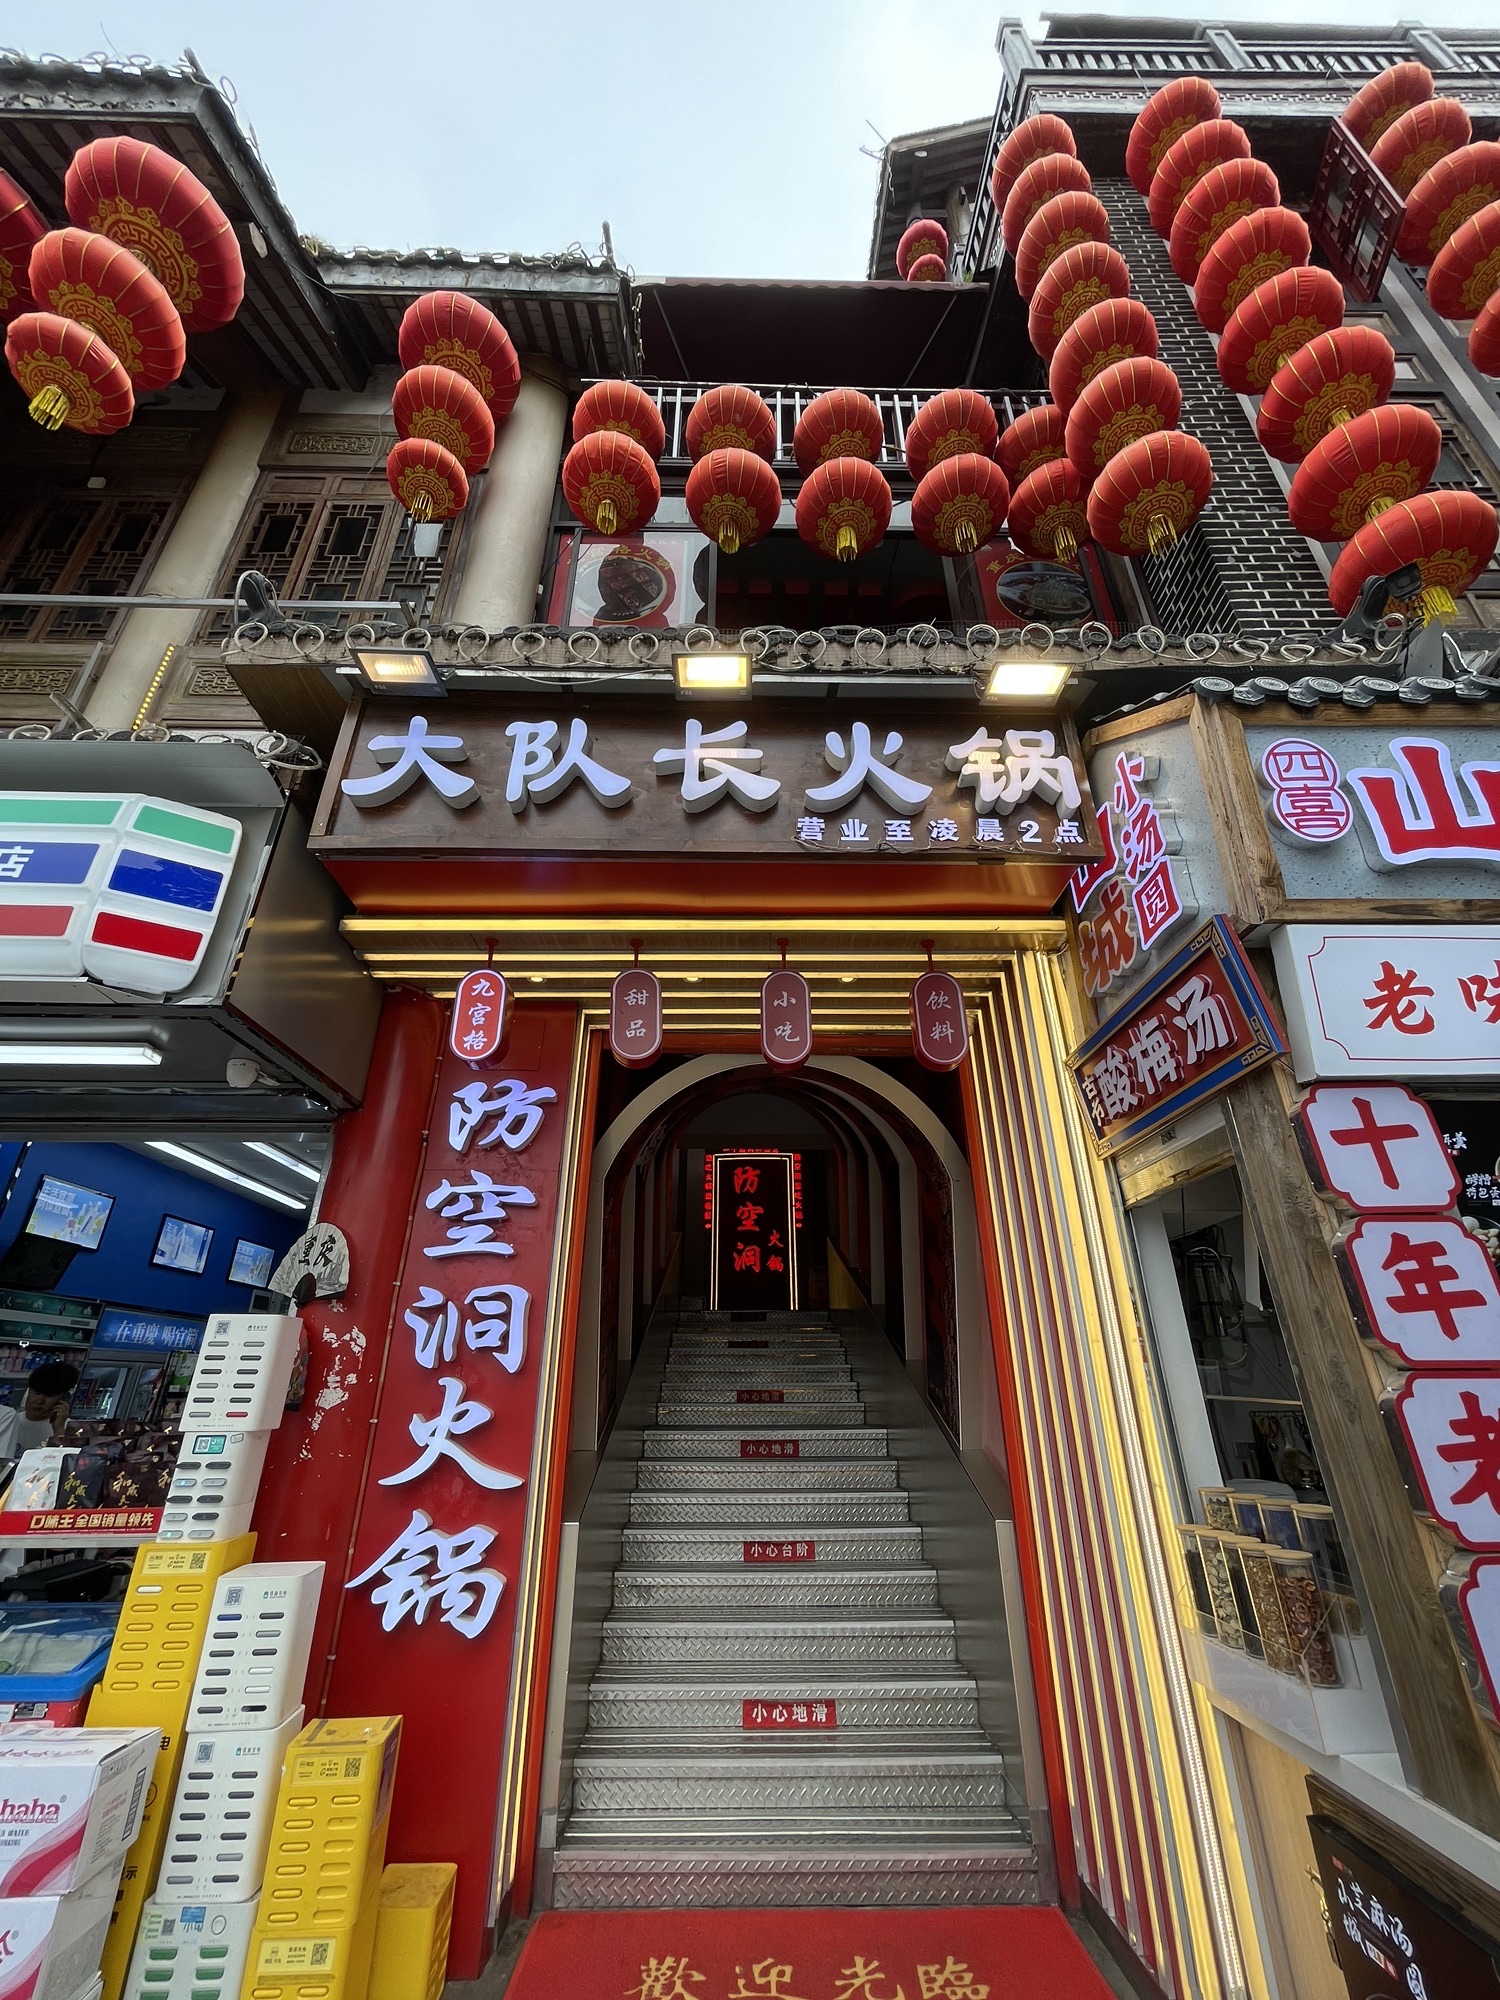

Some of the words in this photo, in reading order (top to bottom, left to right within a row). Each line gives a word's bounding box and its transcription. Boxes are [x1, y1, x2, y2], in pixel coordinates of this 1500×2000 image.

[341, 715, 1081, 817] 大队长火锅
[1264, 739, 1351, 838] 四喜
[1347, 737, 1500, 864] 山
[797, 816, 1084, 844] 营业至凌晨2点
[1114, 751, 1183, 950] 小汤圆
[0, 845, 35, 878] 店
[463, 978, 496, 1052] 九宫格
[623, 988, 650, 1039] 甜品
[772, 990, 800, 1043] 小吃
[926, 990, 955, 1044] 饮料
[1093, 973, 1238, 1120] 酸梅汤
[733, 1166, 764, 1273] 防空洞
[344, 1078, 558, 1640] 防空洞火锅
[746, 1443, 794, 1455] 小心地滑
[750, 1543, 809, 1557] 小心台阶
[752, 1703, 828, 1723] 小心地滑
[623, 1955, 991, 2000] 歡迎光臨
